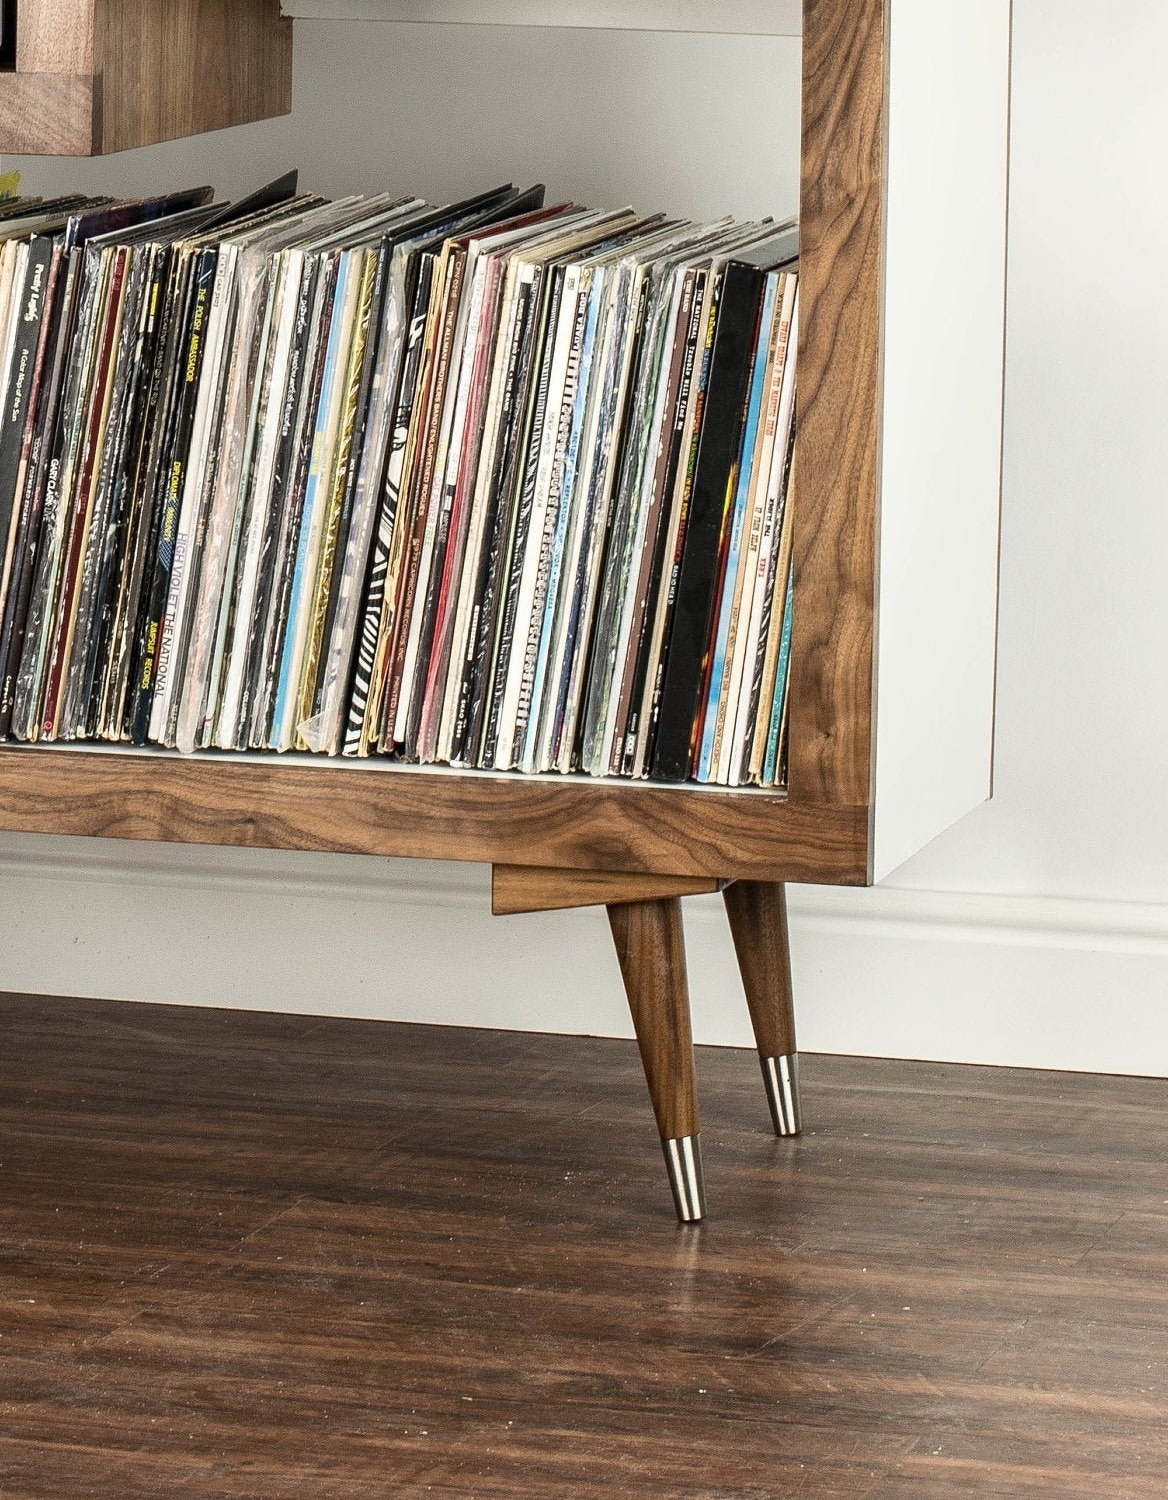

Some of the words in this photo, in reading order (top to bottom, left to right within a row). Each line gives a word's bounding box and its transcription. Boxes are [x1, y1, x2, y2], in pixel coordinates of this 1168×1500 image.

[29, 262, 45, 293] Pretty
[453, 260, 461, 278] CPN
[196, 287, 206, 301] THE
[215, 277, 223, 291] CAD
[449, 277, 459, 298] 0218
[684, 278, 692, 293] THE
[695, 288, 703, 301] THE
[23, 291, 41, 323] Lights
[515, 297, 525, 320] MUSIC
[576, 292, 587, 314] BOP
[681, 293, 690, 313] BAND
[192, 304, 204, 330] POLISH
[445, 309, 454, 328] THE
[689, 303, 701, 340] NATIONAL
[773, 309, 781, 319] IN
[512, 320, 521, 341] FROM
[571, 317, 584, 350] LUAKA
[770, 318, 780, 346] PRINTED
[777, 320, 789, 343] EDWARD
[21, 347, 29, 355] A
[440, 326, 452, 360] ALLMAN
[510, 341, 518, 354] BIG
[18, 354, 28, 372] Color
[155, 349, 164, 368] BAND
[184, 332, 200, 382] AMBASSADOR
[508, 354, 516, 372] PINK
[683, 345, 695, 376] Trouble
[774, 345, 785, 367] SHARPE
[14, 371, 25, 389] Map
[154, 367, 162, 379] ON
[433, 359, 447, 403] BROTHERS
[771, 376, 781, 388] THE
[14, 388, 23, 396] of
[152, 378, 160, 392] THE
[505, 377, 513, 391] THE
[680, 378, 690, 397] Will
[12, 396, 21, 409] the
[149, 391, 158, 405] RUN
[502, 391, 511, 412] BAND
[677, 399, 687, 418] Find
[767, 389, 779, 417] MAGNETIC
[10, 408, 19, 422] Sun
[675, 419, 684, 431] Me
[764, 419, 775, 437] ZEROS
[48, 457, 59, 480] GARY
[24, 464, 35, 499] FORWARD
[166, 460, 181, 503] DIPLOMATIC
[431, 475, 441, 493] CAT
[417, 482, 429, 517] ROGUES
[427, 493, 439, 524] POWER
[559, 484, 570, 524] REFLEKTOR
[754, 505, 762, 514] UP
[20, 498, 30, 526] ESCAPE
[42, 506, 52, 523] LIVE
[751, 515, 761, 532] FROM
[763, 523, 771, 537] THE
[424, 524, 434, 547] FREE
[748, 533, 759, 552] BELOW
[173, 531, 187, 565] HIGH
[166, 564, 183, 608] VIOLET
[404, 561, 417, 608] CAPRICORN
[162, 610, 176, 636] THE
[146, 620, 158, 654] JUMPSUIT
[140, 657, 153, 690] RECORDS
[153, 635, 172, 699] NATIONAL
[1, 674, 12, 705] Carpark
[389, 674, 401, 709] PRINTED
[387, 708, 396, 719] IN
[457, 698, 466, 719] SKAO
[717, 699, 727, 723] CHONG
[715, 724, 723, 737] AND
[711, 738, 722, 764] CHEECH
